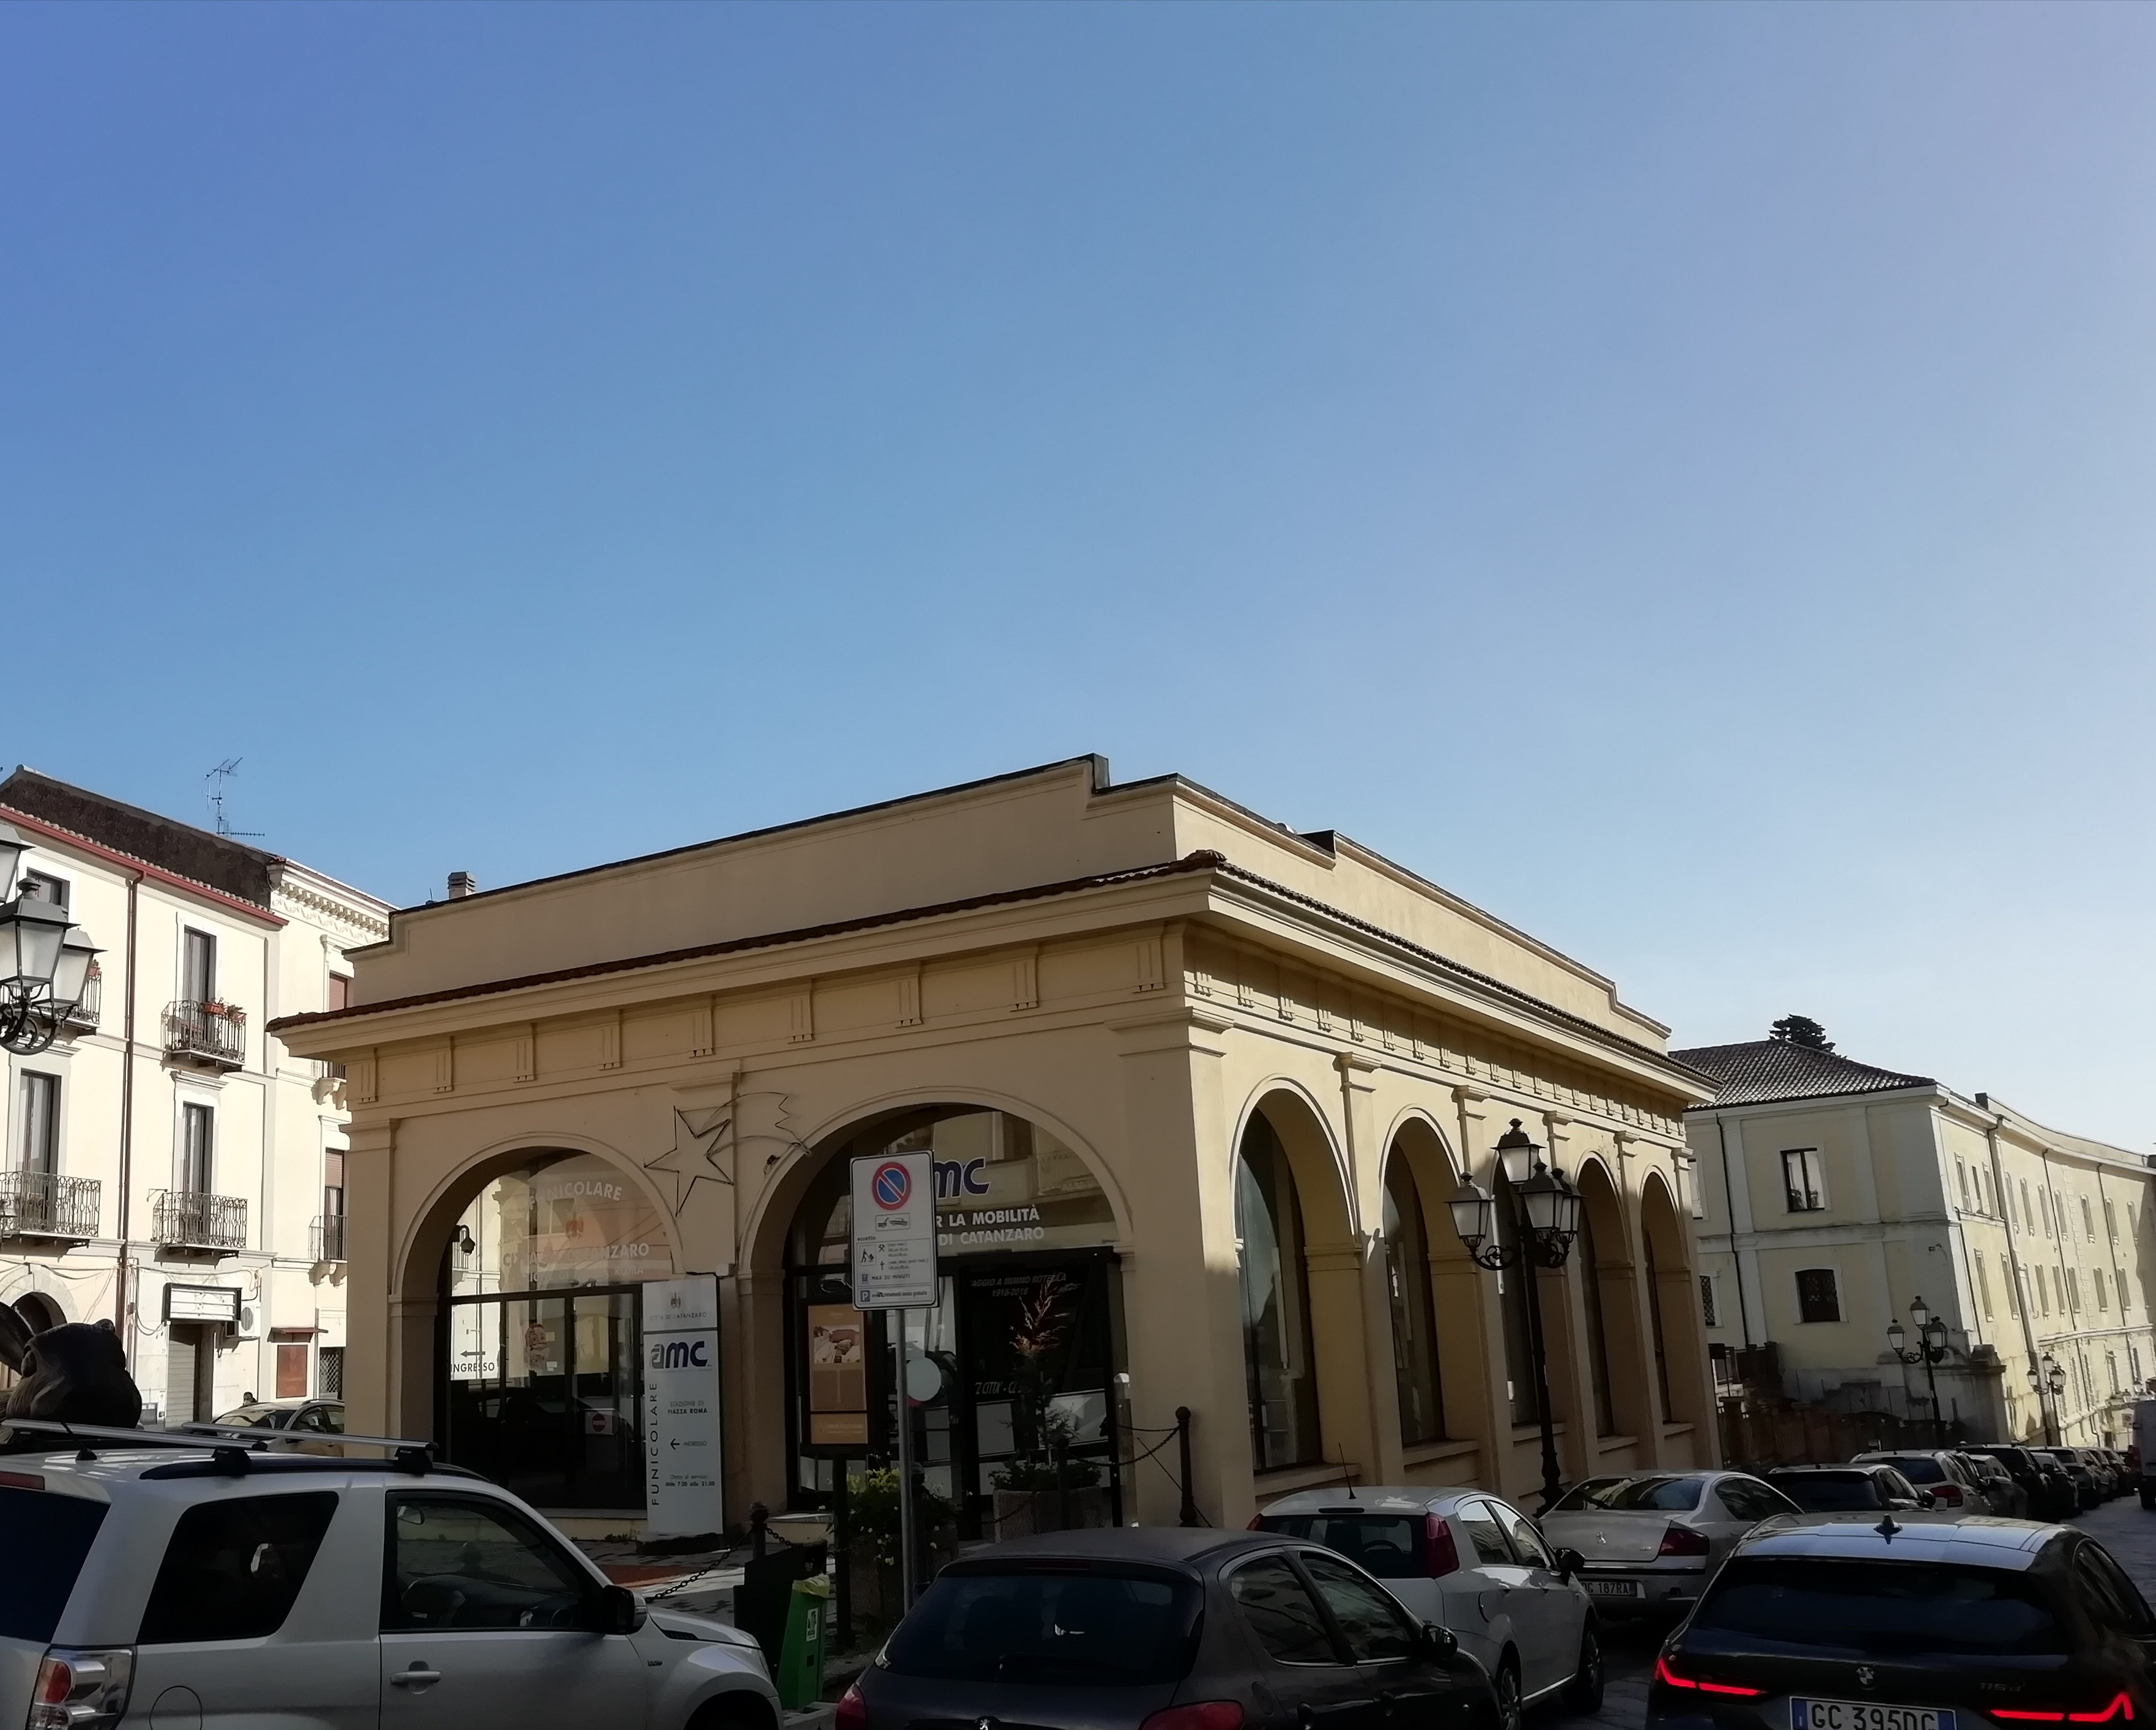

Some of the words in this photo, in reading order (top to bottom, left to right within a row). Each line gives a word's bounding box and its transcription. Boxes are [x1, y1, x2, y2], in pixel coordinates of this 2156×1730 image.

[529, 1181, 623, 1211] FNICOLARE
[949, 1213, 966, 1227] LA
[972, 1204, 1040, 1225] MOBILITÀ
[939, 1234, 953, 1247] DI
[960, 1226, 1045, 1245] CATANZARO
[615, 1267, 644, 1277] ROMA
[650, 1340, 708, 1369] amc
[450, 1362, 495, 1372] INGRESSO
[649, 1383, 660, 1505] FUNICOLARE
[1598, 1582, 1629, 1594] 187RA
[1812, 1703, 1842, 1730] GC
